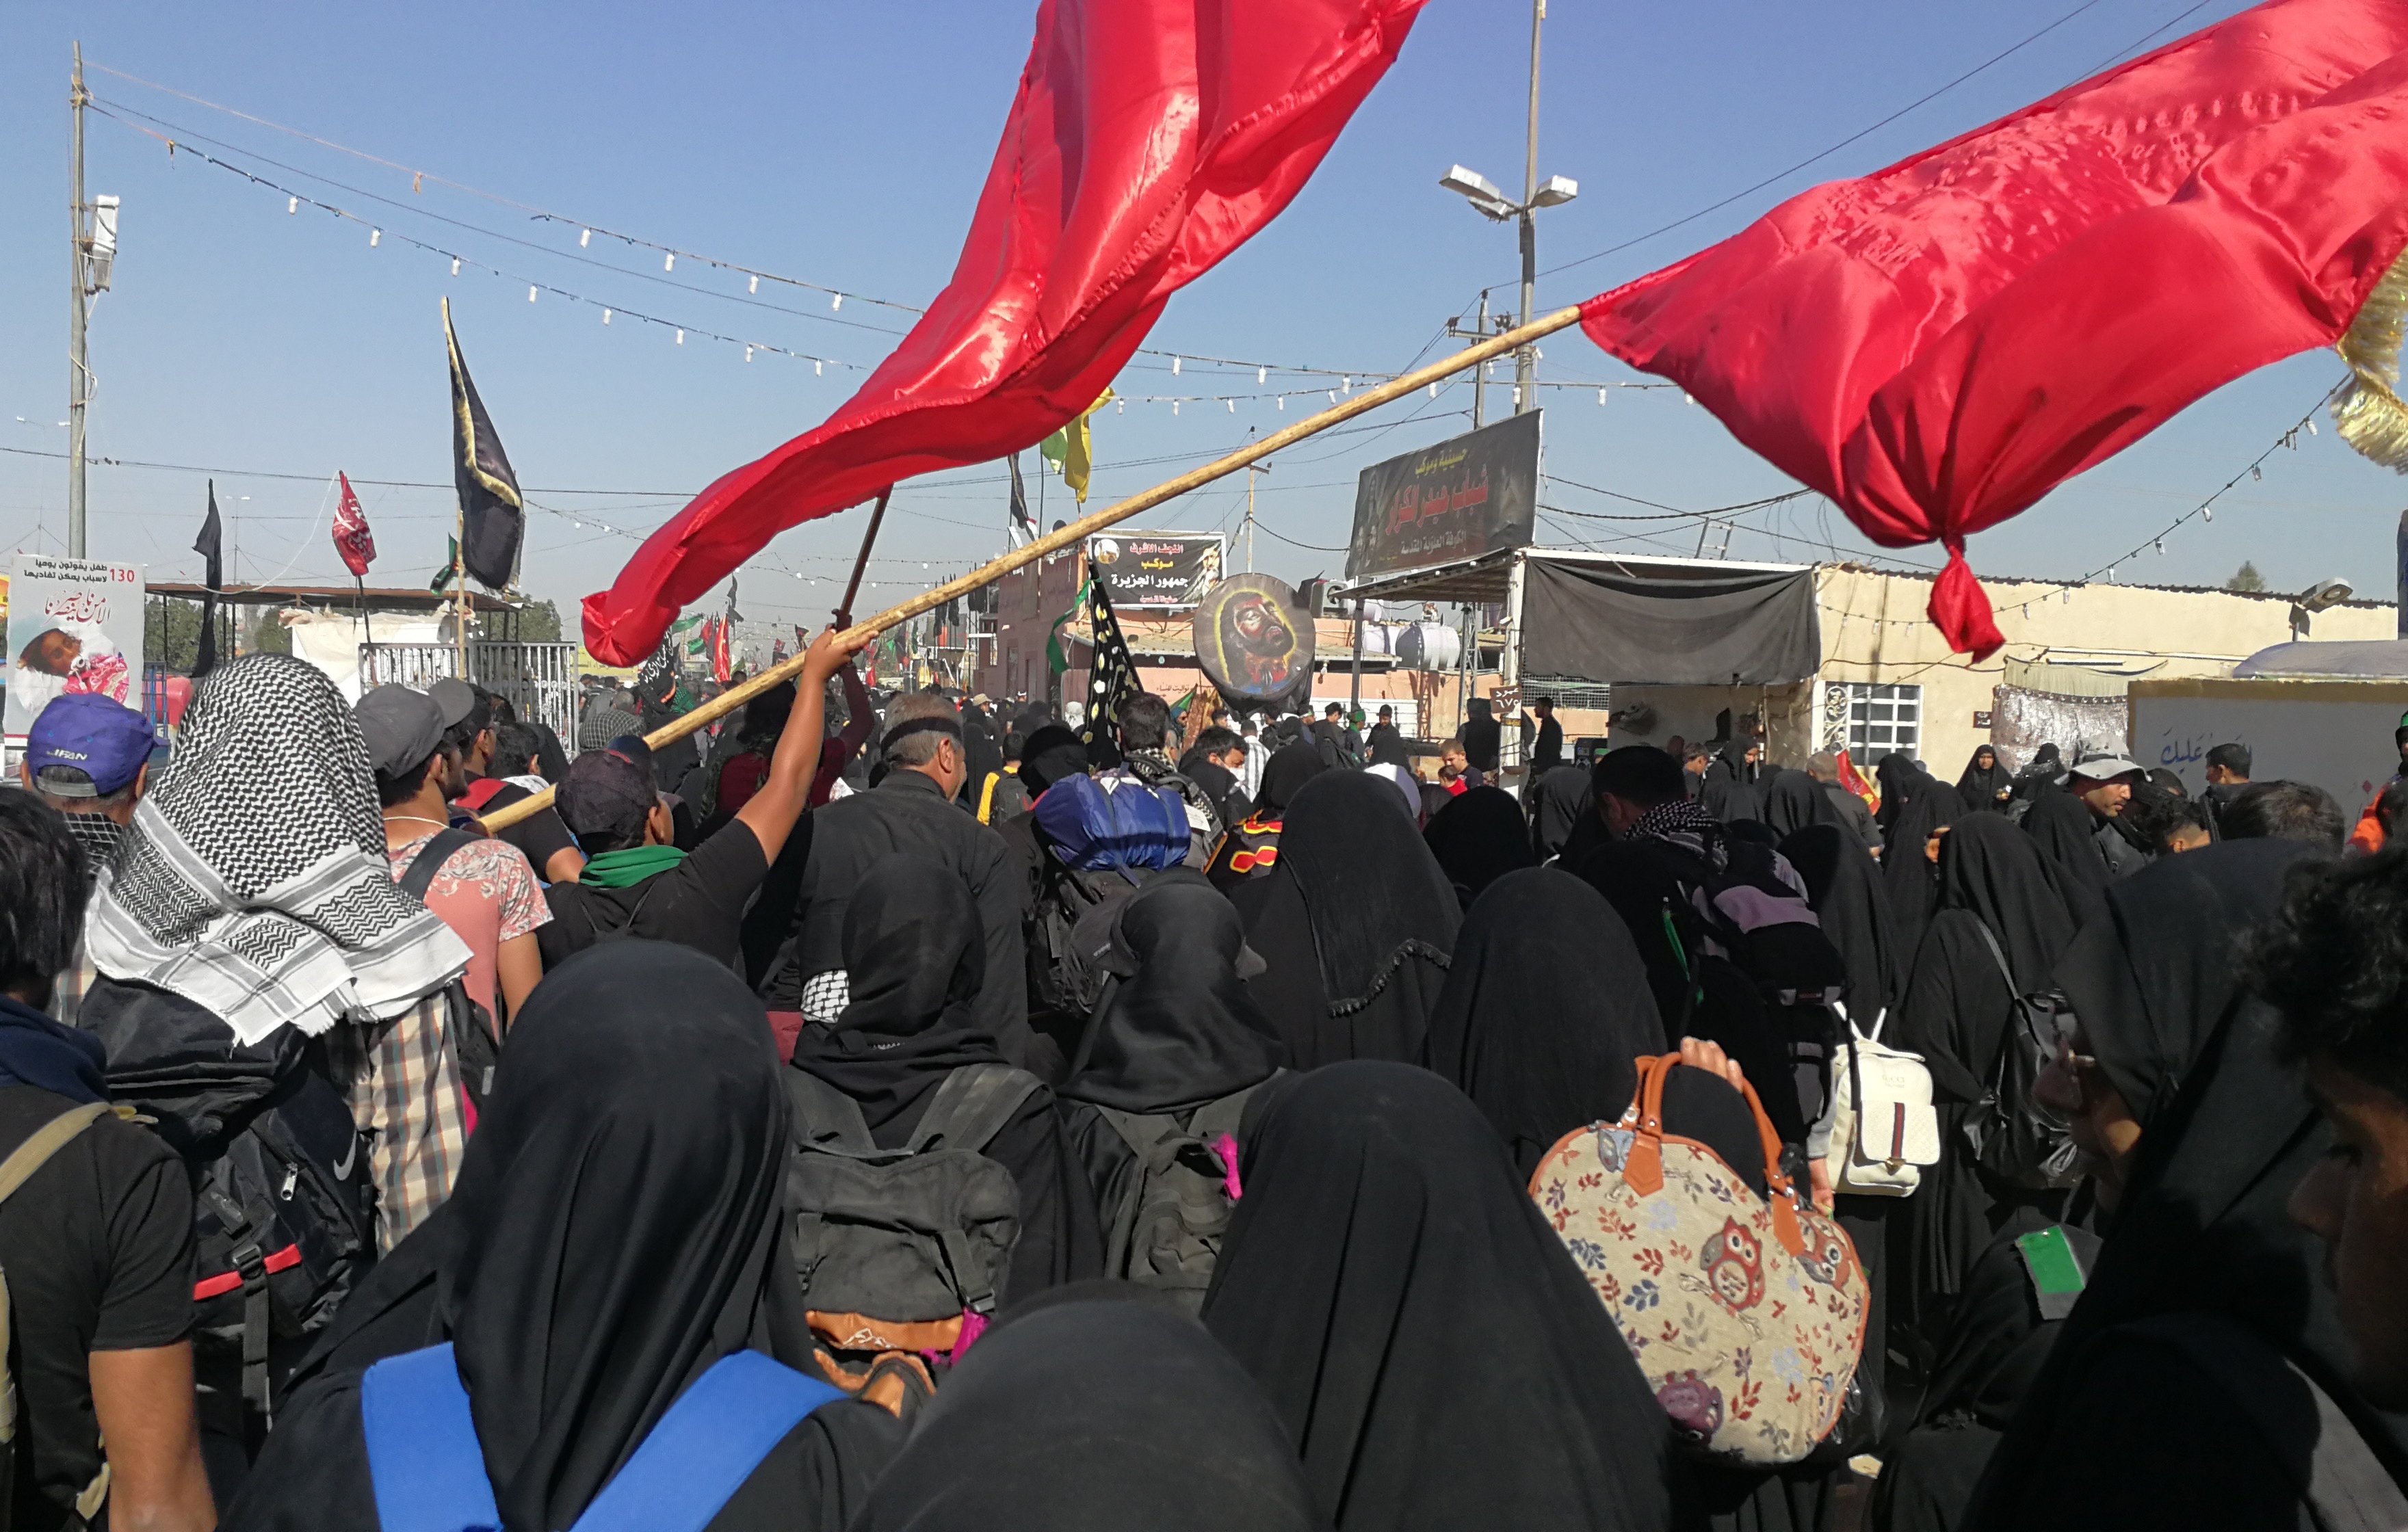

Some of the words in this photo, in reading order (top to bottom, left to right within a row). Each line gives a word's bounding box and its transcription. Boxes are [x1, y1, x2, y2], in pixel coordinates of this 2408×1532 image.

[1439, 449, 1468, 471] حسينية
[1415, 456, 1439, 479] وموكب
[1452, 464, 1489, 518] شباب
[1385, 483, 1420, 536] الكرار
[1417, 485, 1450, 528] حيدر
[1129, 542, 1157, 555] الاشرف
[1158, 543, 1184, 555] النجف
[36, 558, 57, 569] يوميا
[59, 560, 88, 572] يموتون
[90, 563, 107, 572] طفل
[1140, 557, 1174, 570] موكب
[24, 569, 56, 579] تفاديها
[58, 572, 81, 583] يمكن
[82, 573, 107, 583] لاسباب
[109, 568, 135, 583] 130
[1111, 573, 1153, 588] الجزيرة
[1155, 577, 1188, 588] جمهور
[1495, 687, 1519, 698] عمود
